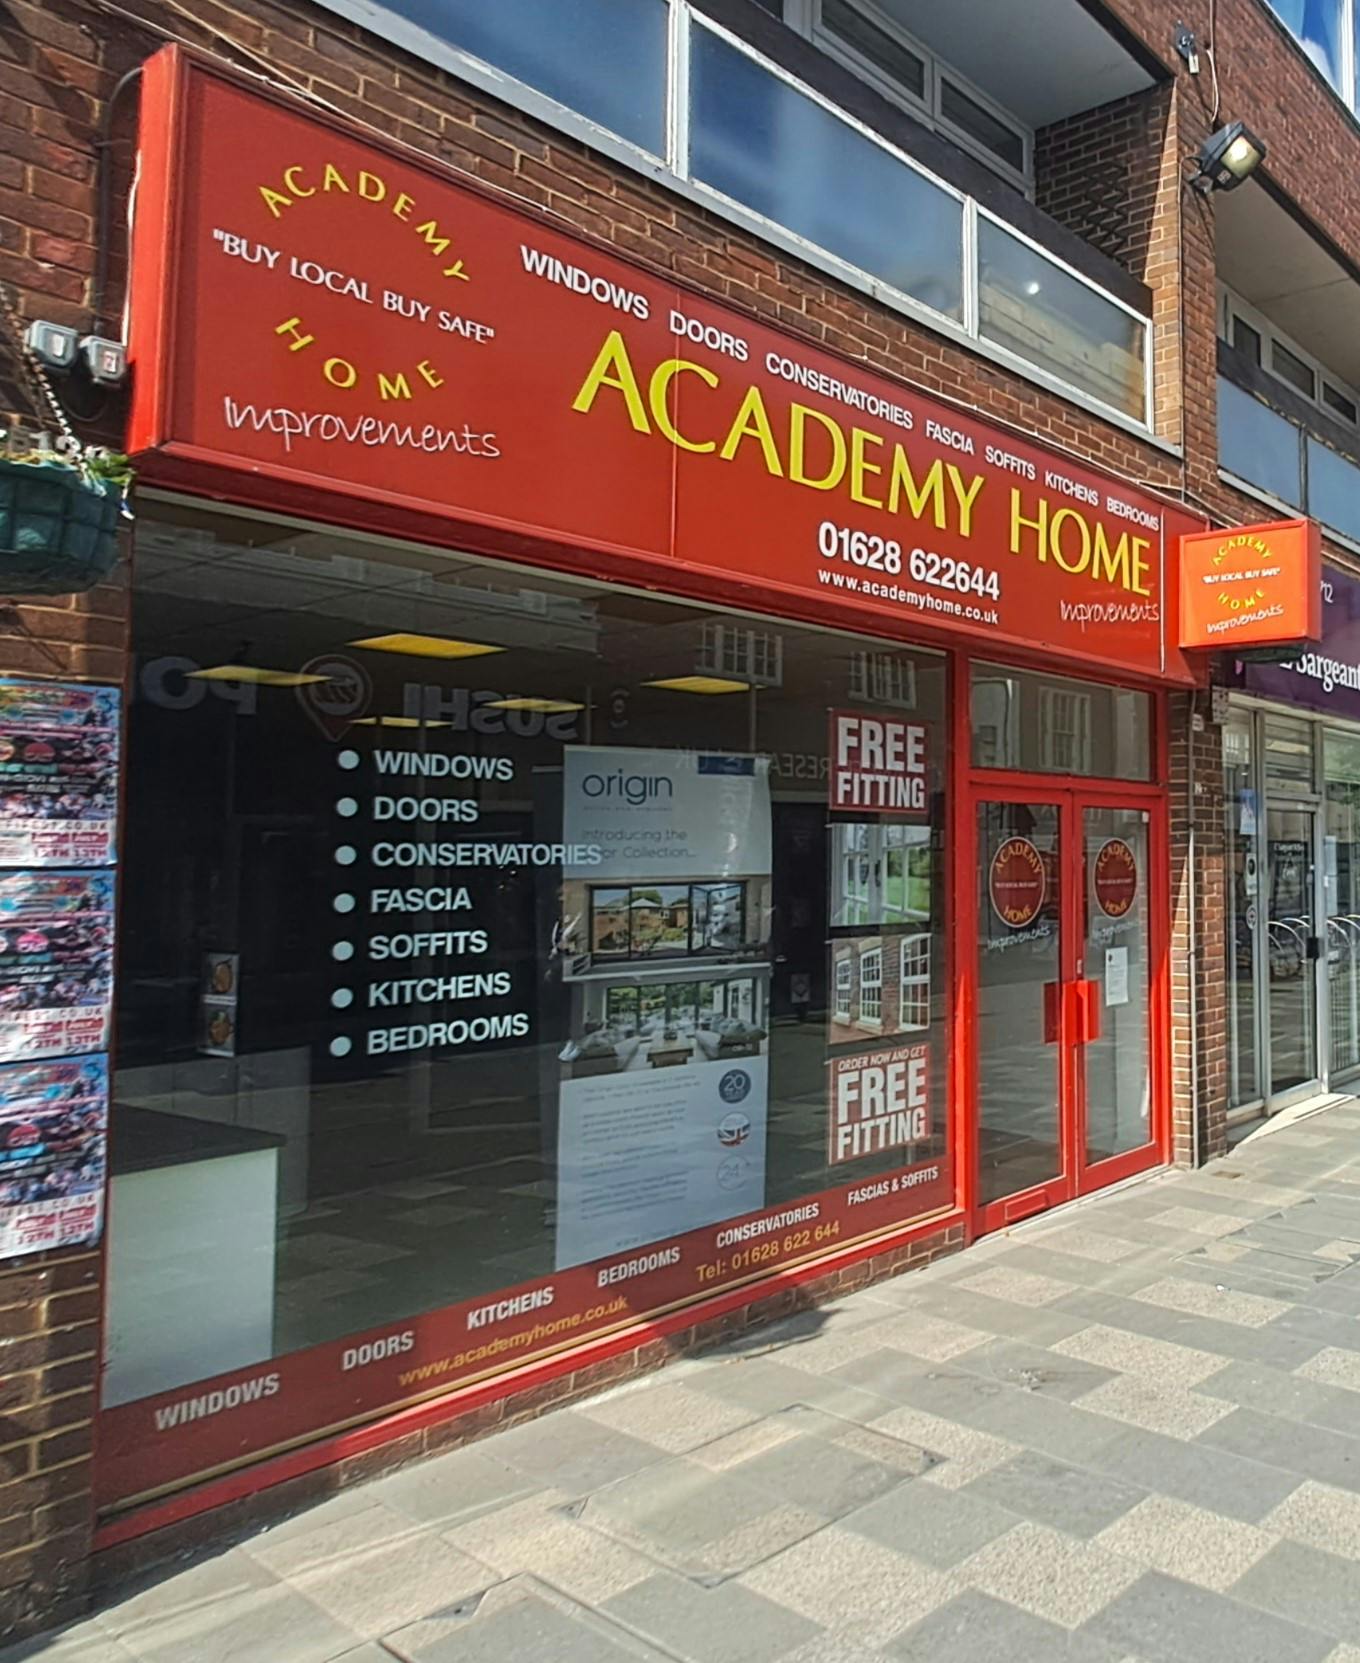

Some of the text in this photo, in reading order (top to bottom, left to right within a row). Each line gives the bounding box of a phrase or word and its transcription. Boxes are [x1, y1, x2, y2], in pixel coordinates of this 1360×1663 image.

[259, 164, 470, 282] ACADEMY
[213, 229, 495, 343] "BUY LOCAL BUY SAFE"
[275, 316, 444, 401] HOME
[520, 245, 1159, 531] WINDOWS DOORS CONSERVATORIES FASCIA SOFFITS KITCHENS BEDROOMS
[223, 396, 501, 459] Improvements
[572, 329, 1151, 596] ACADEMY HOME
[818, 521, 999, 602] 01628 622644
[1212, 536, 1272, 566] ACADEMY
[818, 569, 999, 626] www.academyhome.co.uk
[1060, 598, 1160, 632] Improvements
[1217, 588, 1265, 610] HOME
[373, 749, 514, 781] WINDOWS
[837, 716, 925, 774] FREE
[582, 768, 673, 805] origin
[837, 771, 925, 809] FITTING
[373, 796, 478, 823] DOORS
[371, 843, 602, 868] CONSERVATORIES
[665, 829, 687, 841] the
[994, 841, 1042, 874] ACADEMY
[370, 887, 472, 913] FASCIA
[368, 930, 488, 961] SOFFITS
[367, 972, 511, 1008] KITCHENS
[366, 1013, 529, 1057] BEDROOMS
[838, 1045, 927, 1072] ORDER NOW AND GET
[724, 1075, 746, 1091] 20
[837, 1057, 927, 1125] FREE
[837, 1106, 926, 1160] FITTING
[696, 1220, 841, 1285] Tel: 01628 622 644
[154, 1373, 281, 1431] WINDOWS
[342, 1331, 414, 1371] DOORS
[467, 1286, 555, 1331] KITCHENS
[597, 1247, 681, 1287] BEDROOMS
[716, 1203, 820, 1248] CONSERVATORIES
[847, 1180, 888, 1207] FASCIAS
[891, 1175, 899, 1193] &
[901, 1166, 939, 1191] SOFFITS
[398, 1295, 628, 1387] www.academyhome.co.uk
